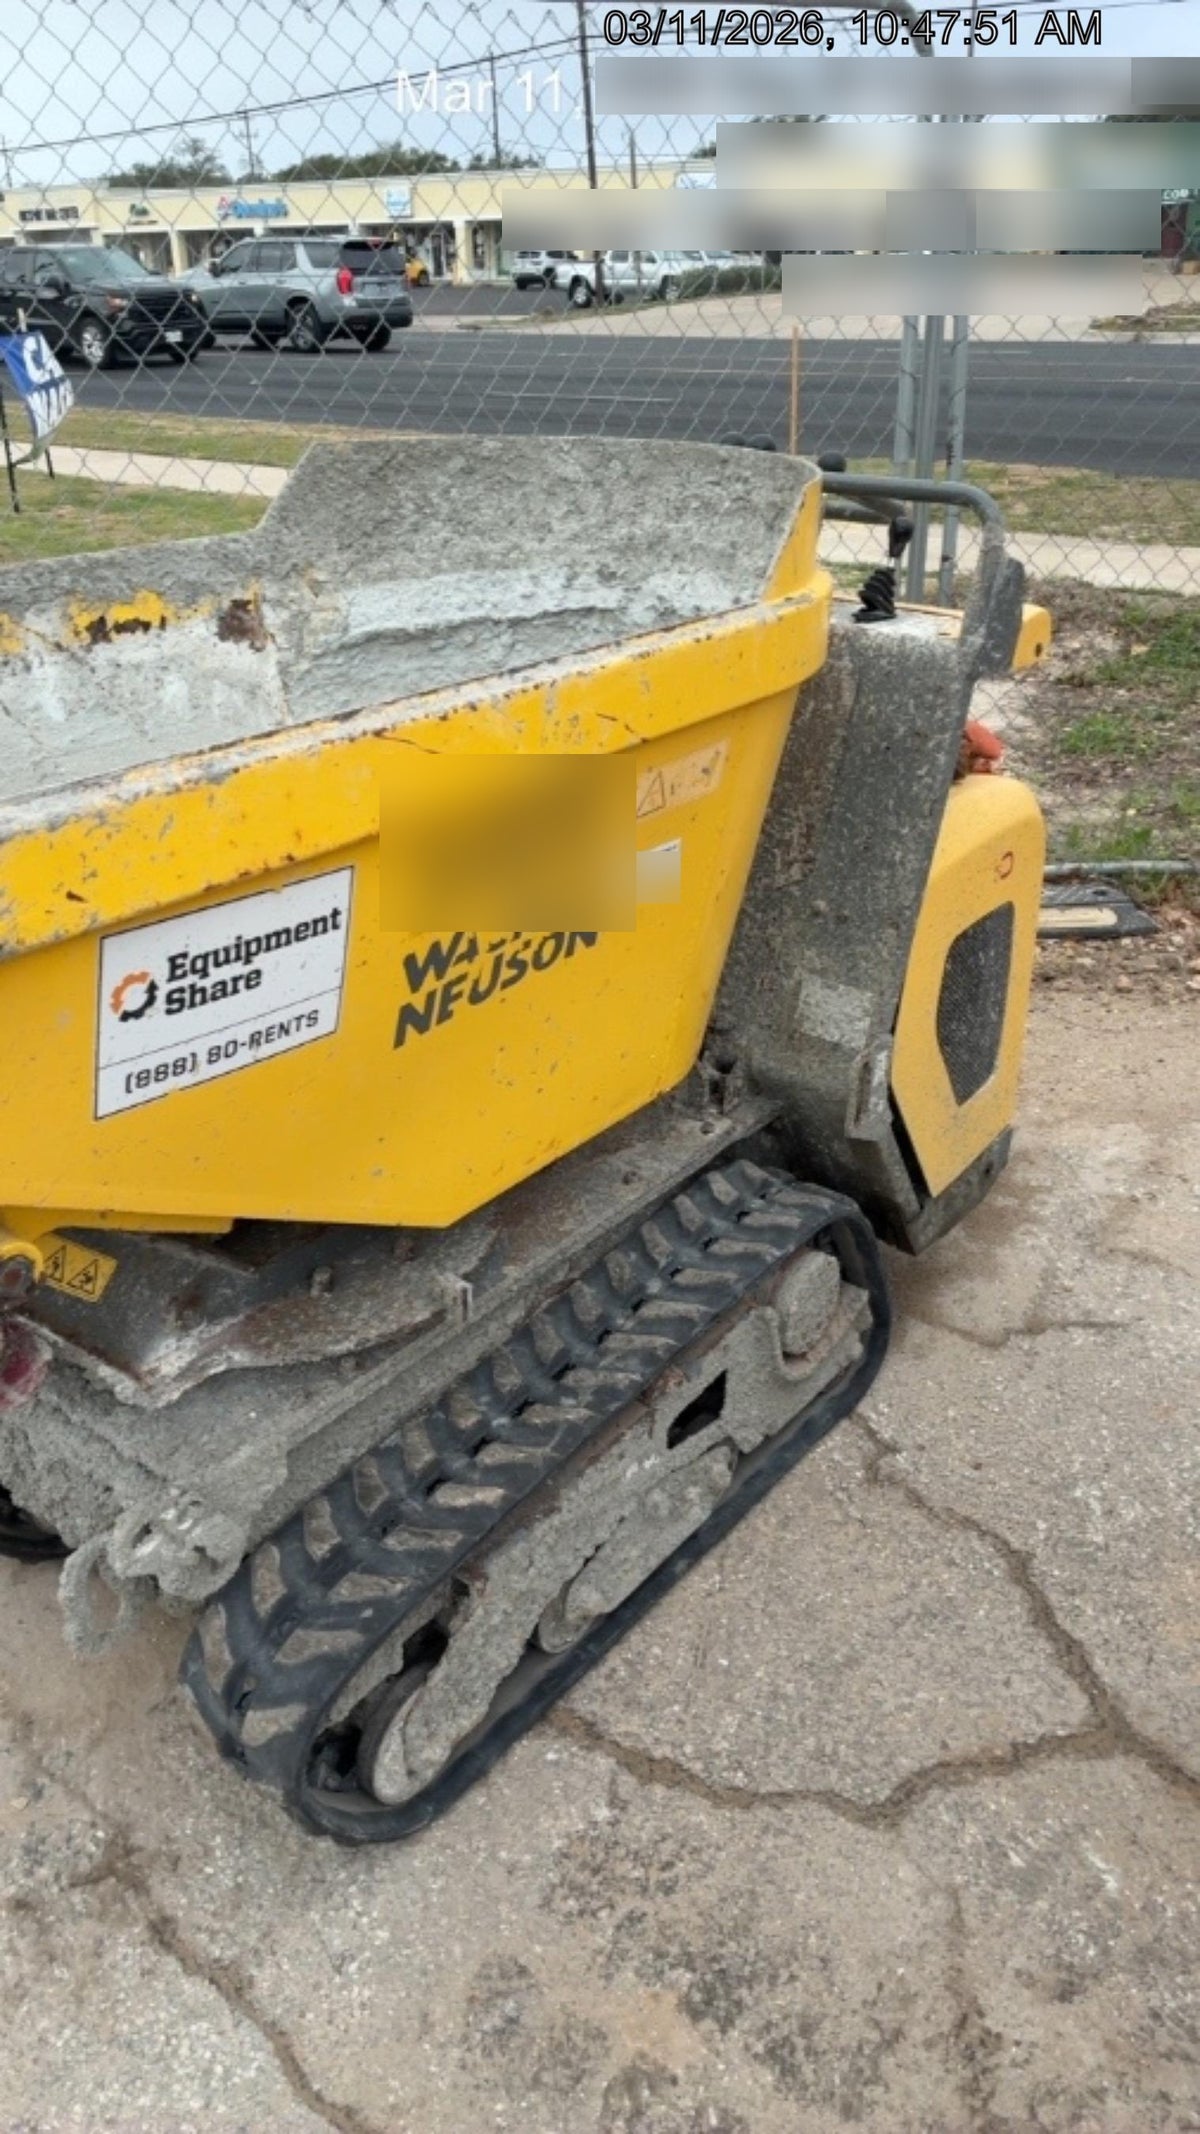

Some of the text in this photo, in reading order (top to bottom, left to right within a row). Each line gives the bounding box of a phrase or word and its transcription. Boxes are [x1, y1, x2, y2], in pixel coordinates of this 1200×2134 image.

[165, 906, 342, 985] Equipment
[164, 967, 263, 1017] Share
[124, 1008, 320, 1095] (888) 80-RENTS
